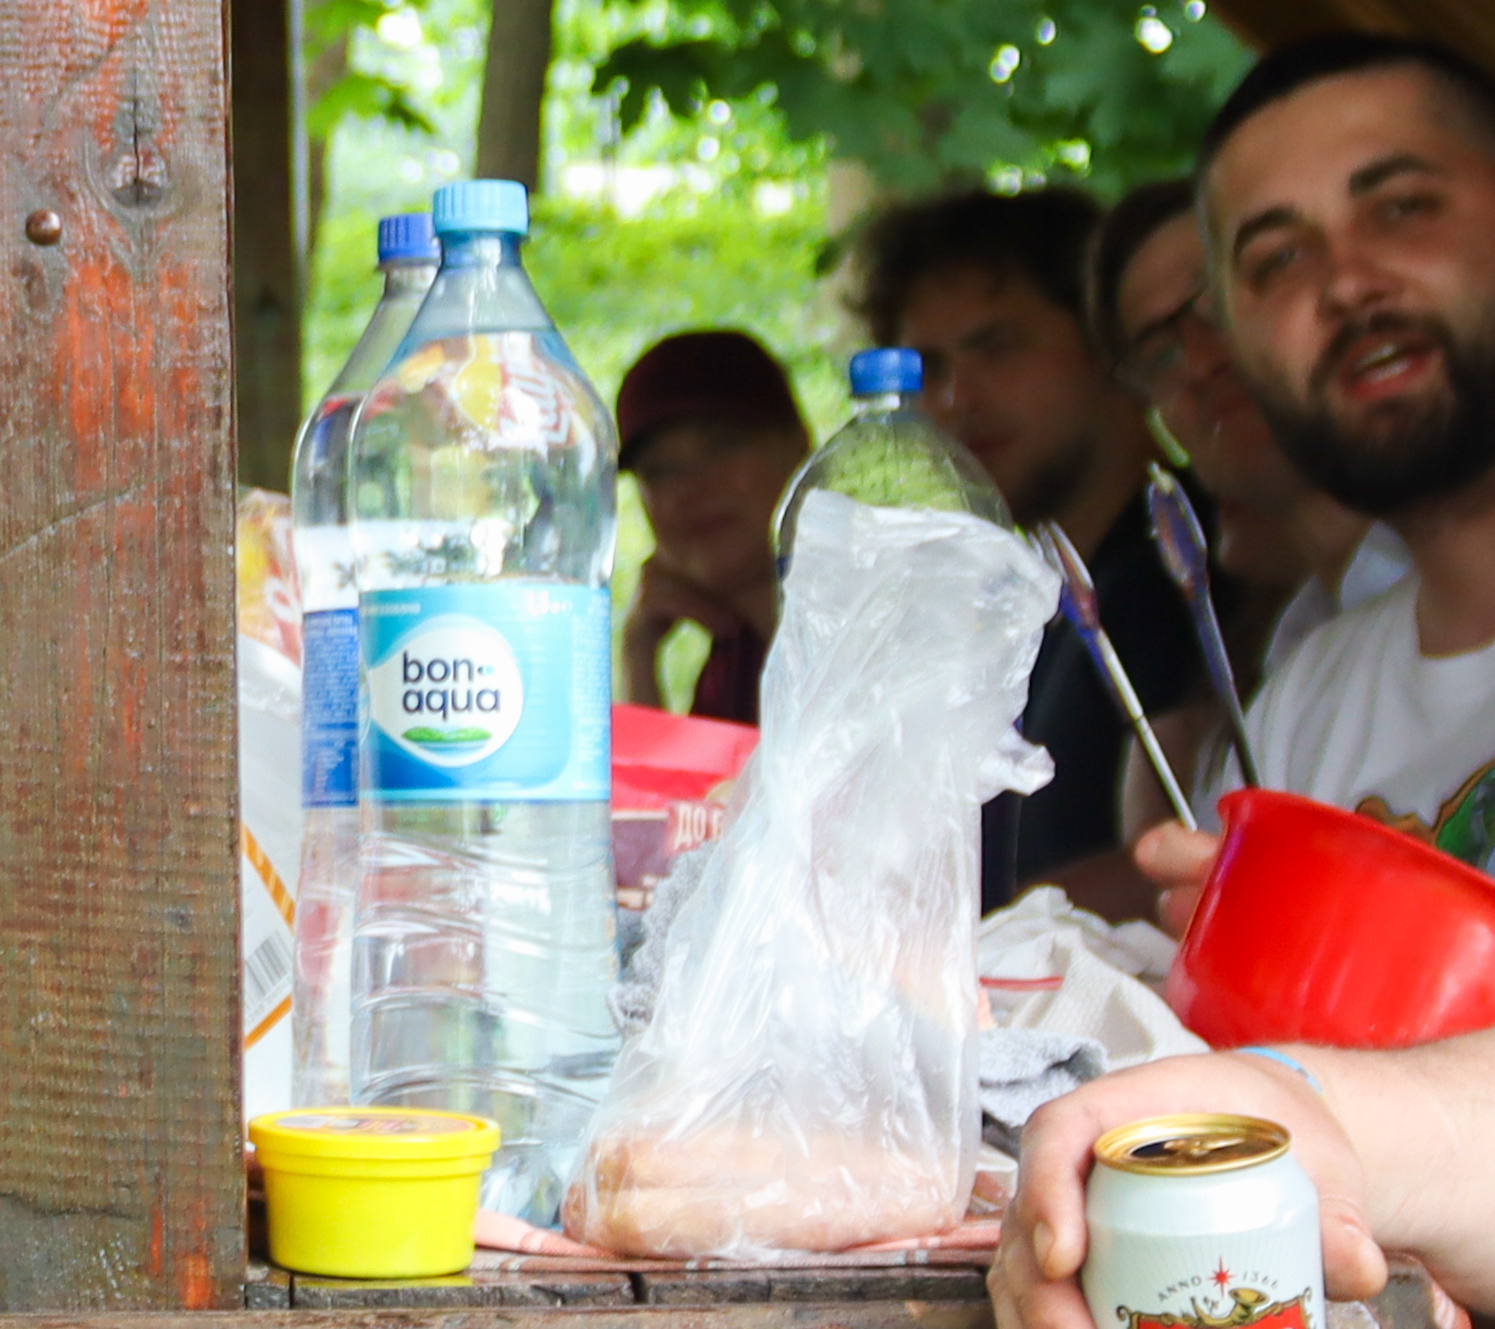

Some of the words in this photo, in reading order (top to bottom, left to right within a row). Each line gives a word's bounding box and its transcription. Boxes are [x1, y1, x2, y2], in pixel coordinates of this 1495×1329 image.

[402, 686, 500, 721] aqua
[1157, 1274, 1203, 1303] ANNO
[1242, 1270, 1279, 1290] 1366
